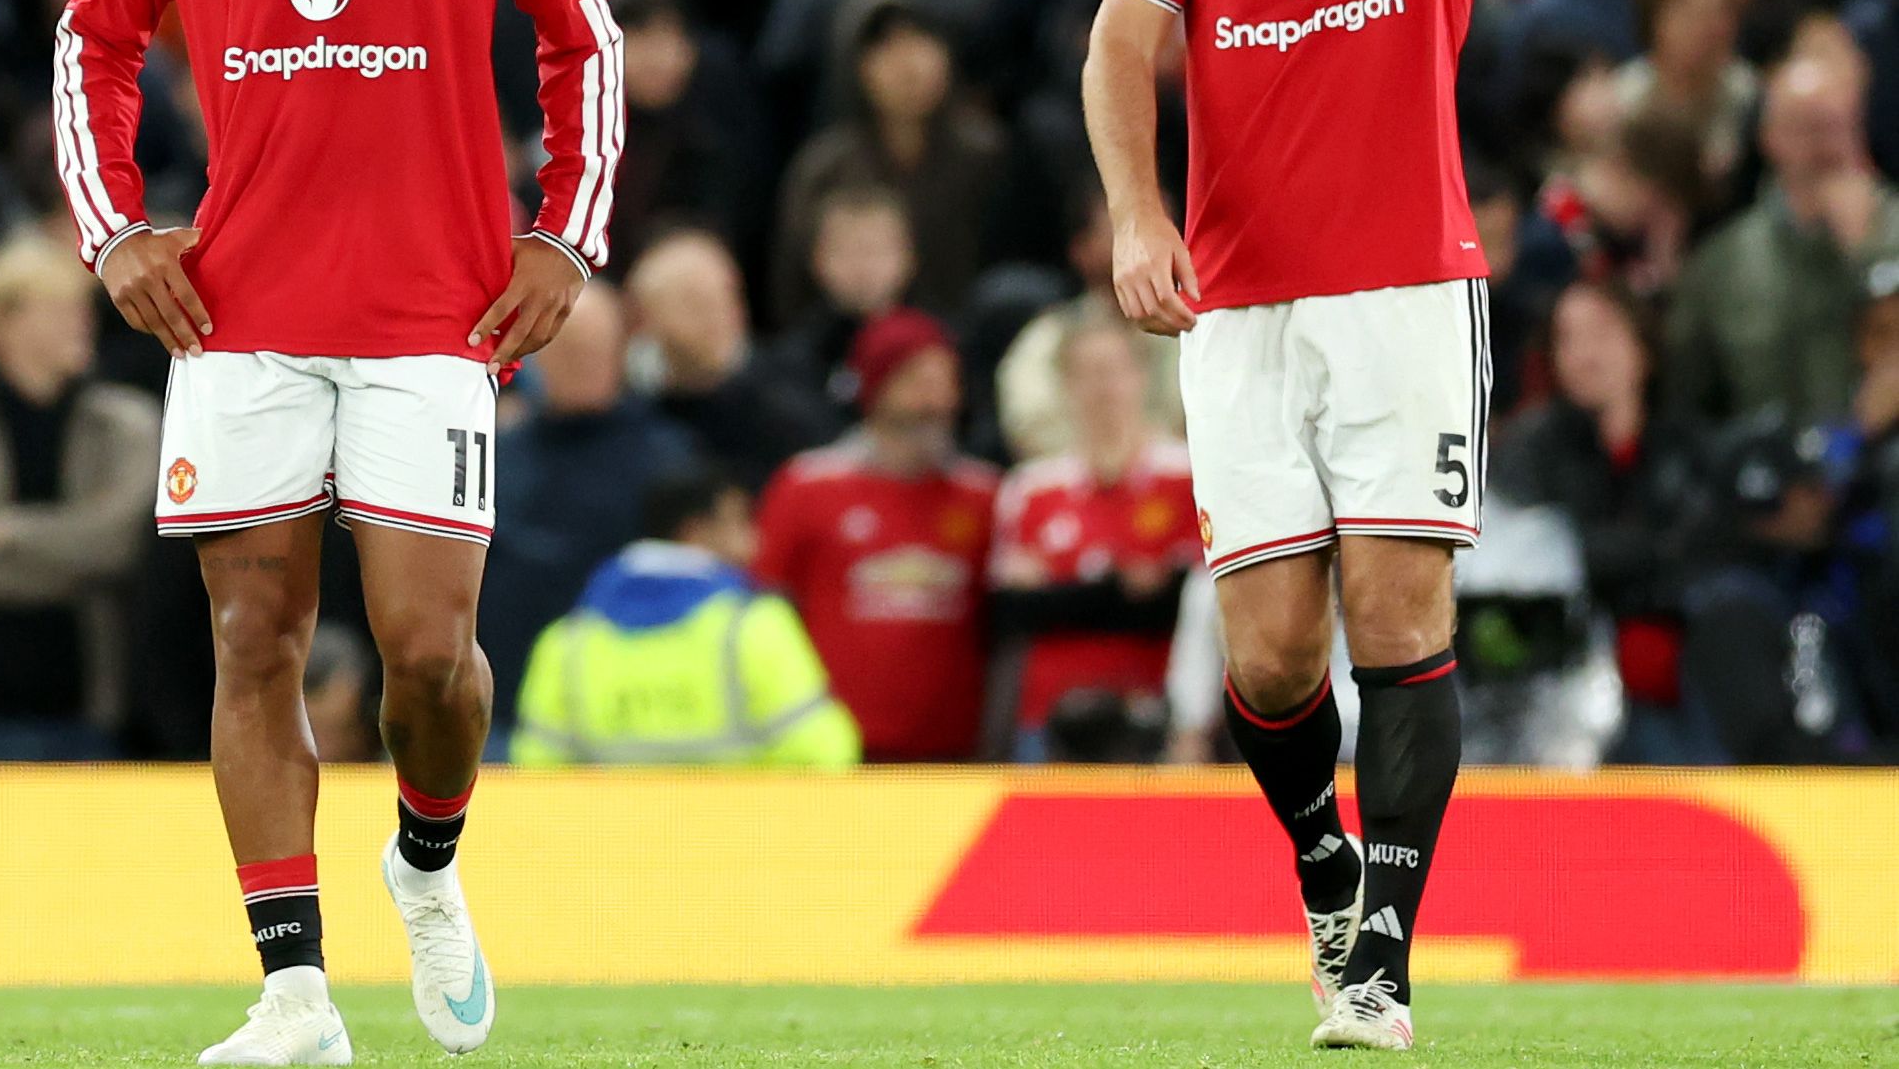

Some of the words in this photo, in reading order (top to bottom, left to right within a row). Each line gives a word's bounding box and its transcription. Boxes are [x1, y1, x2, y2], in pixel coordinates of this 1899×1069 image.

[223, 36, 428, 81] Snapdragon
[447, 428, 487, 511] 11
[1433, 432, 1469, 509] 5
[1368, 842, 1420, 869] MUFC
[251, 921, 302, 943] MUFC
